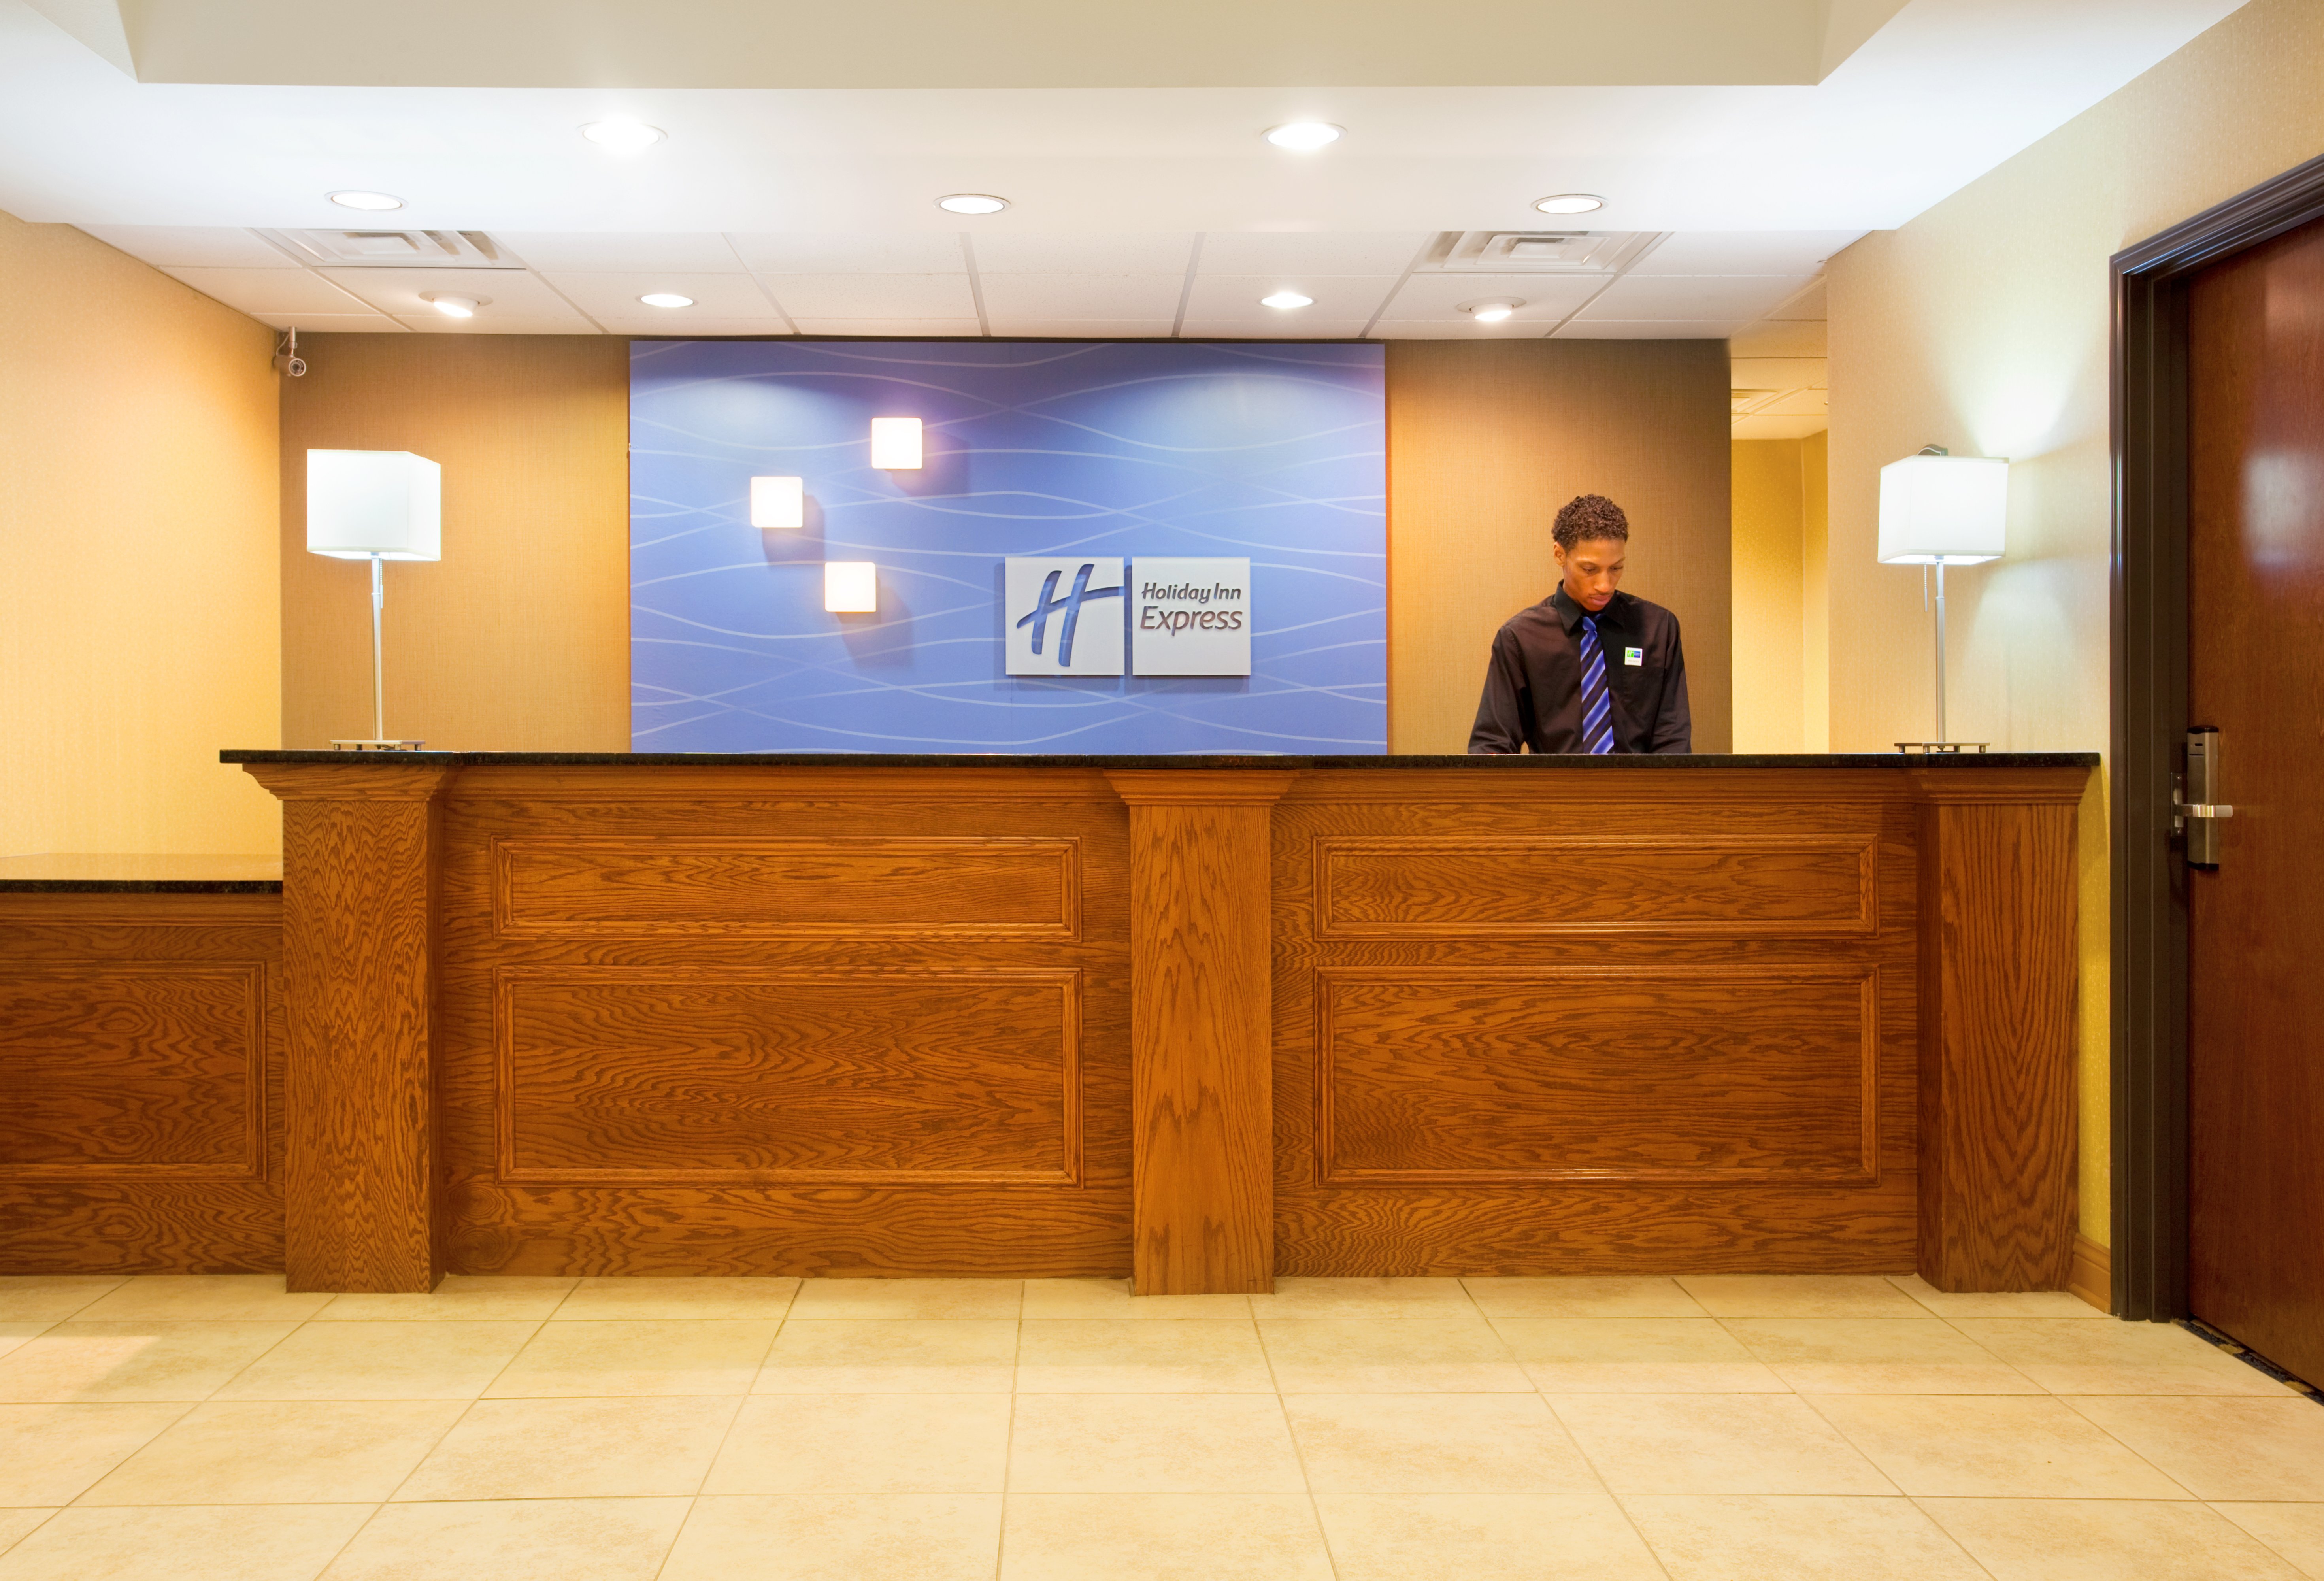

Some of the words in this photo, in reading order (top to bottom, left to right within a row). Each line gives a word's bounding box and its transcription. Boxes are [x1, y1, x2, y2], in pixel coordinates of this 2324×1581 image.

[1141, 582, 1211, 604] Holiday
[1213, 583, 1241, 600] Inn
[1140, 606, 1243, 636] Express
